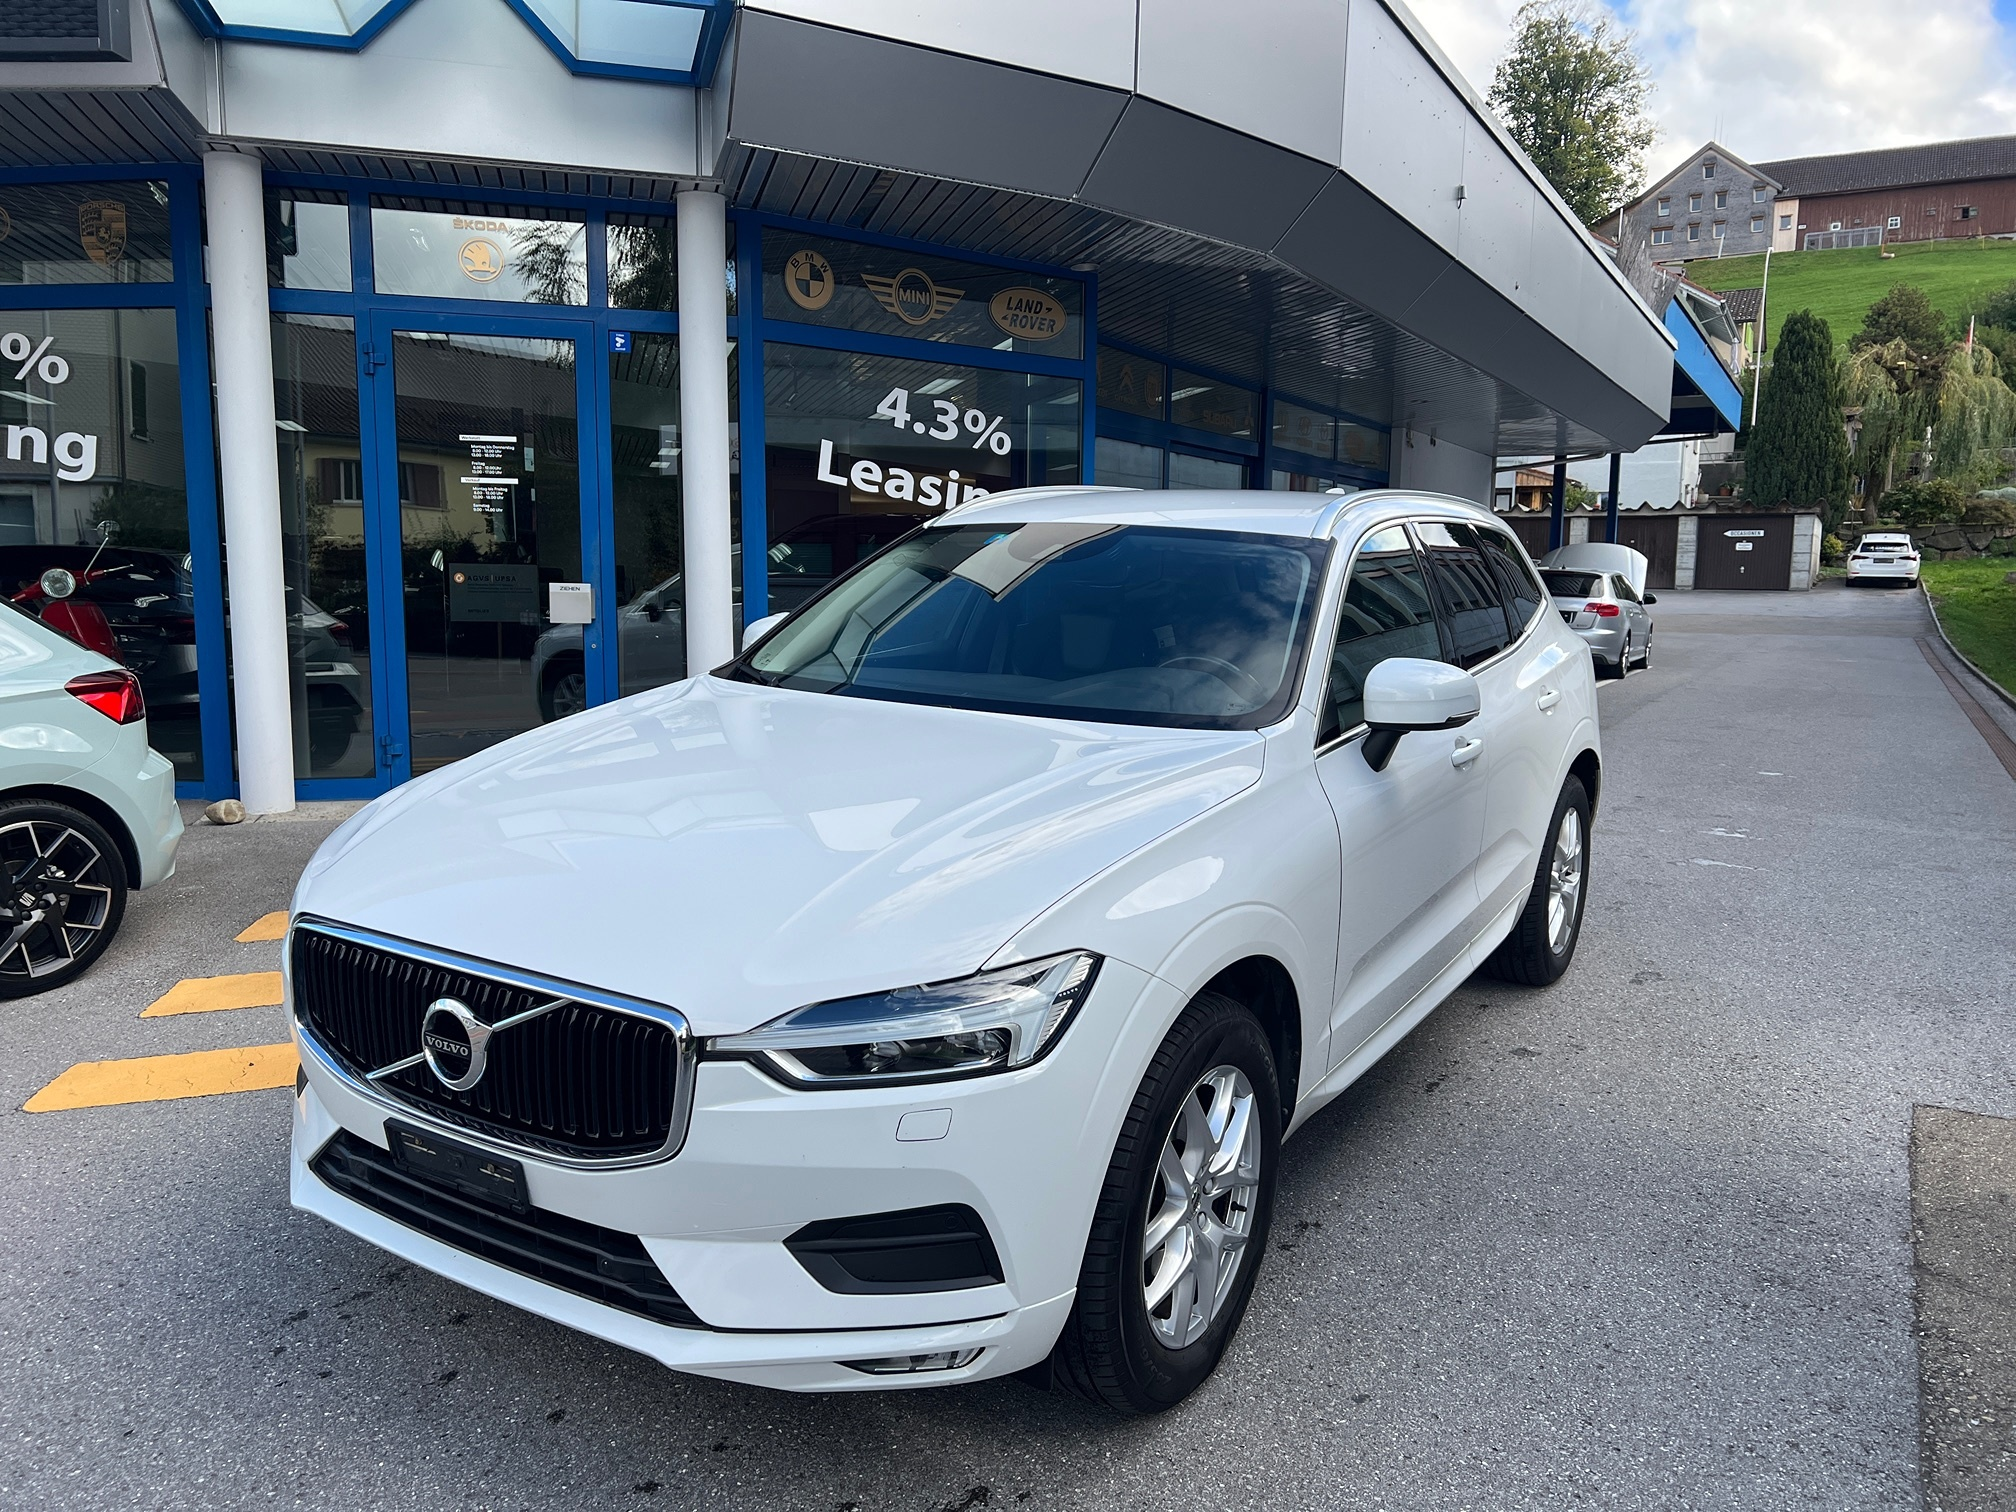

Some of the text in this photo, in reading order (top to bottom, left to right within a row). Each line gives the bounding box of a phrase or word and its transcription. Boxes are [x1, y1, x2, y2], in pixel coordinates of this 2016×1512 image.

[453, 217, 508, 233] ŠKODA
[790, 252, 829, 273] BMW
[899, 288, 930, 305] MINI
[1006, 296, 1043, 315] LAND
[1008, 315, 1057, 334] ROVER
[876, 387, 1012, 456] 4.3%
[817, 438, 991, 510] Leasin
[426, 1036, 469, 1056] VOLVO
